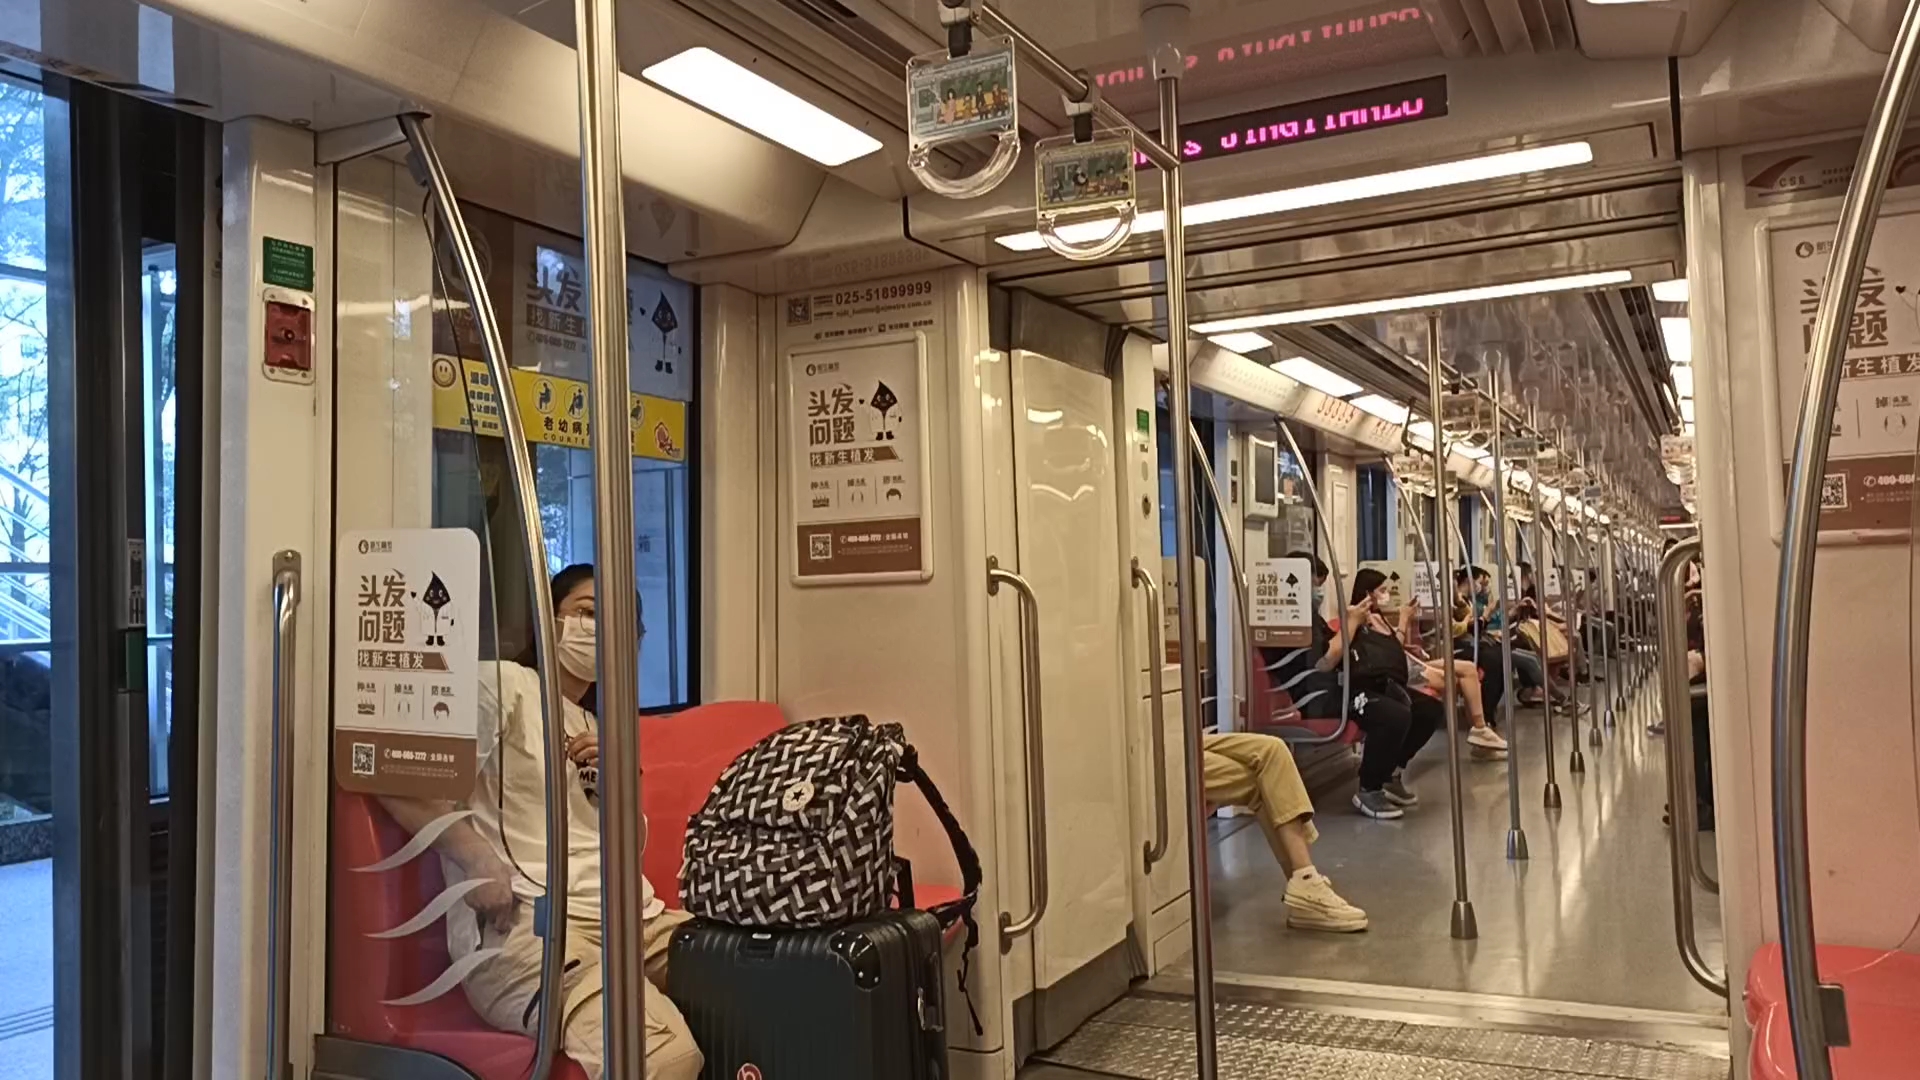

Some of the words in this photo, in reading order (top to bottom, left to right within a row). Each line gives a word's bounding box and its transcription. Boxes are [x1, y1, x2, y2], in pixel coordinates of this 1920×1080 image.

[1779, 175, 1806, 187] CSR
[835, 280, 932, 305] 025-51899999
[808, 382, 855, 417] 头发
[543, 432, 586, 446] COURTE
[809, 416, 855, 446] 问题
[810, 448, 875, 467] 找新生植发
[357, 567, 407, 608] 头发
[358, 610, 406, 644] 问题
[358, 650, 424, 669] 找新生植发
